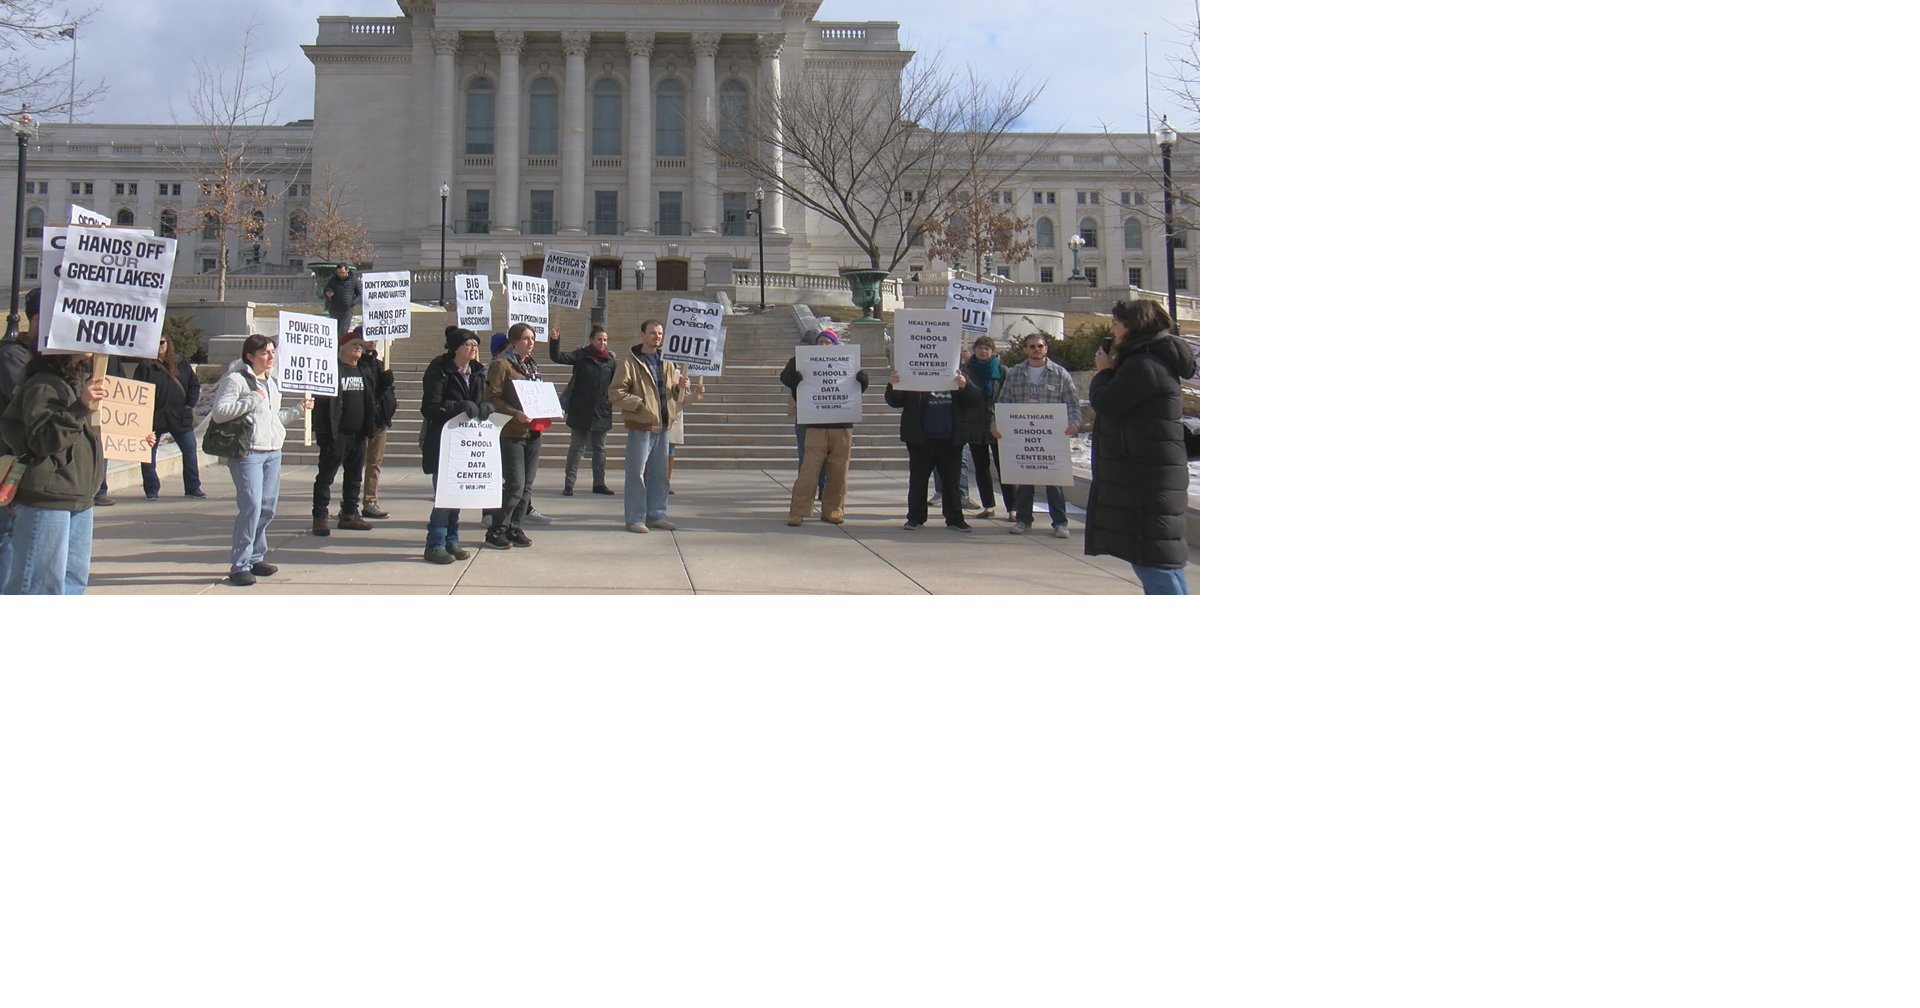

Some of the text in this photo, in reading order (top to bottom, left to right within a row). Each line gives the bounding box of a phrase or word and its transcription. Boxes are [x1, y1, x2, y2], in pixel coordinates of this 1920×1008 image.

[78, 234, 132, 256] HANDS
[135, 242, 165, 260] OFF
[101, 254, 139, 269] OUR
[547, 254, 587, 269] AMERICA'S
[67, 262, 116, 284] GREAT
[115, 268, 165, 289] LAKES!
[545, 264, 585, 278] DAIRYLAND
[364, 279, 409, 289] DON'T POISON OUR
[466, 278, 480, 289] BIG
[511, 280, 546, 294] NO DATA
[554, 280, 570, 290] NOT
[952, 282, 992, 295] OpenAI
[368, 289, 407, 300] AIR AND WATER
[463, 289, 484, 301] TECH
[511, 291, 546, 305] CENTERS
[548, 287, 577, 298] MERICA'S
[953, 293, 989, 305] Oracle
[550, 296, 578, 306] TA-LAND
[61, 297, 159, 323] MORATORIUM
[368, 308, 407, 320] HANDS OFF
[466, 306, 484, 315] OUT OF
[673, 304, 719, 316] OpenAI
[952, 306, 986, 326] UT!
[379, 318, 397, 326] OUR
[460, 316, 490, 326] WISCONSIN
[510, 314, 548, 325] DON'T POISON OUR
[690, 313, 698, 321] &
[288, 320, 330, 336] POWER TO
[365, 324, 409, 337] GREAT LAKES!
[672, 318, 715, 330] Oracle
[76, 319, 138, 348] NOW!
[285, 332, 333, 349] THE PEOPLE
[668, 335, 710, 356] OUT!
[290, 355, 328, 371] NOT TO
[284, 368, 333, 385] BIG TECH
[103, 376, 149, 406] SAVE
[101, 405, 140, 428] OUR
[458, 422, 494, 430] HEALTHCARE
[104, 434, 148, 453] AKES
[470, 450, 486, 458] NOT
